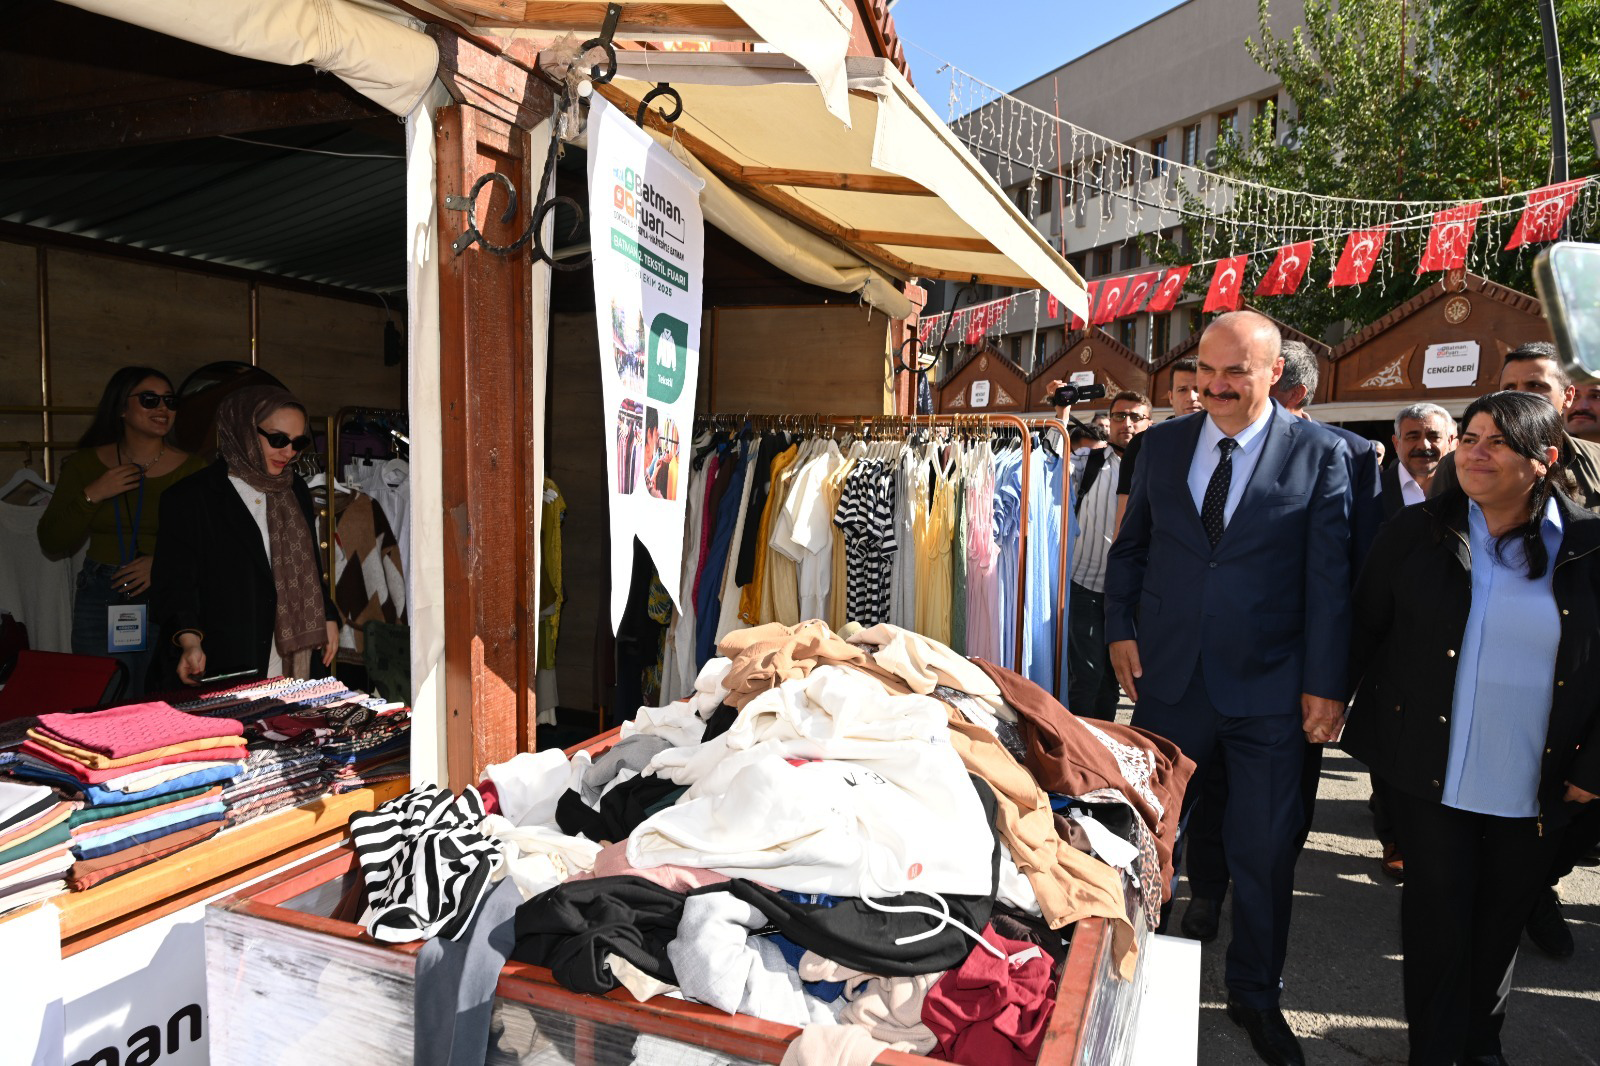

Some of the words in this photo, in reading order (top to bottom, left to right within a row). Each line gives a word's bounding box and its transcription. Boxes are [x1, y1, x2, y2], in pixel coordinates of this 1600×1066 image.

[635, 173, 681, 224] Batman
[614, 235, 638, 259] BATMAN
[643, 252, 667, 276] TEKSTİL
[667, 268, 686, 287] FUARI
[657, 281, 673, 297] 2025
[657, 373, 673, 387] Tekstil
[1427, 365, 1455, 374] CENGİZ
[1456, 363, 1475, 373] DERİ
[70, 1003, 203, 1066] an
